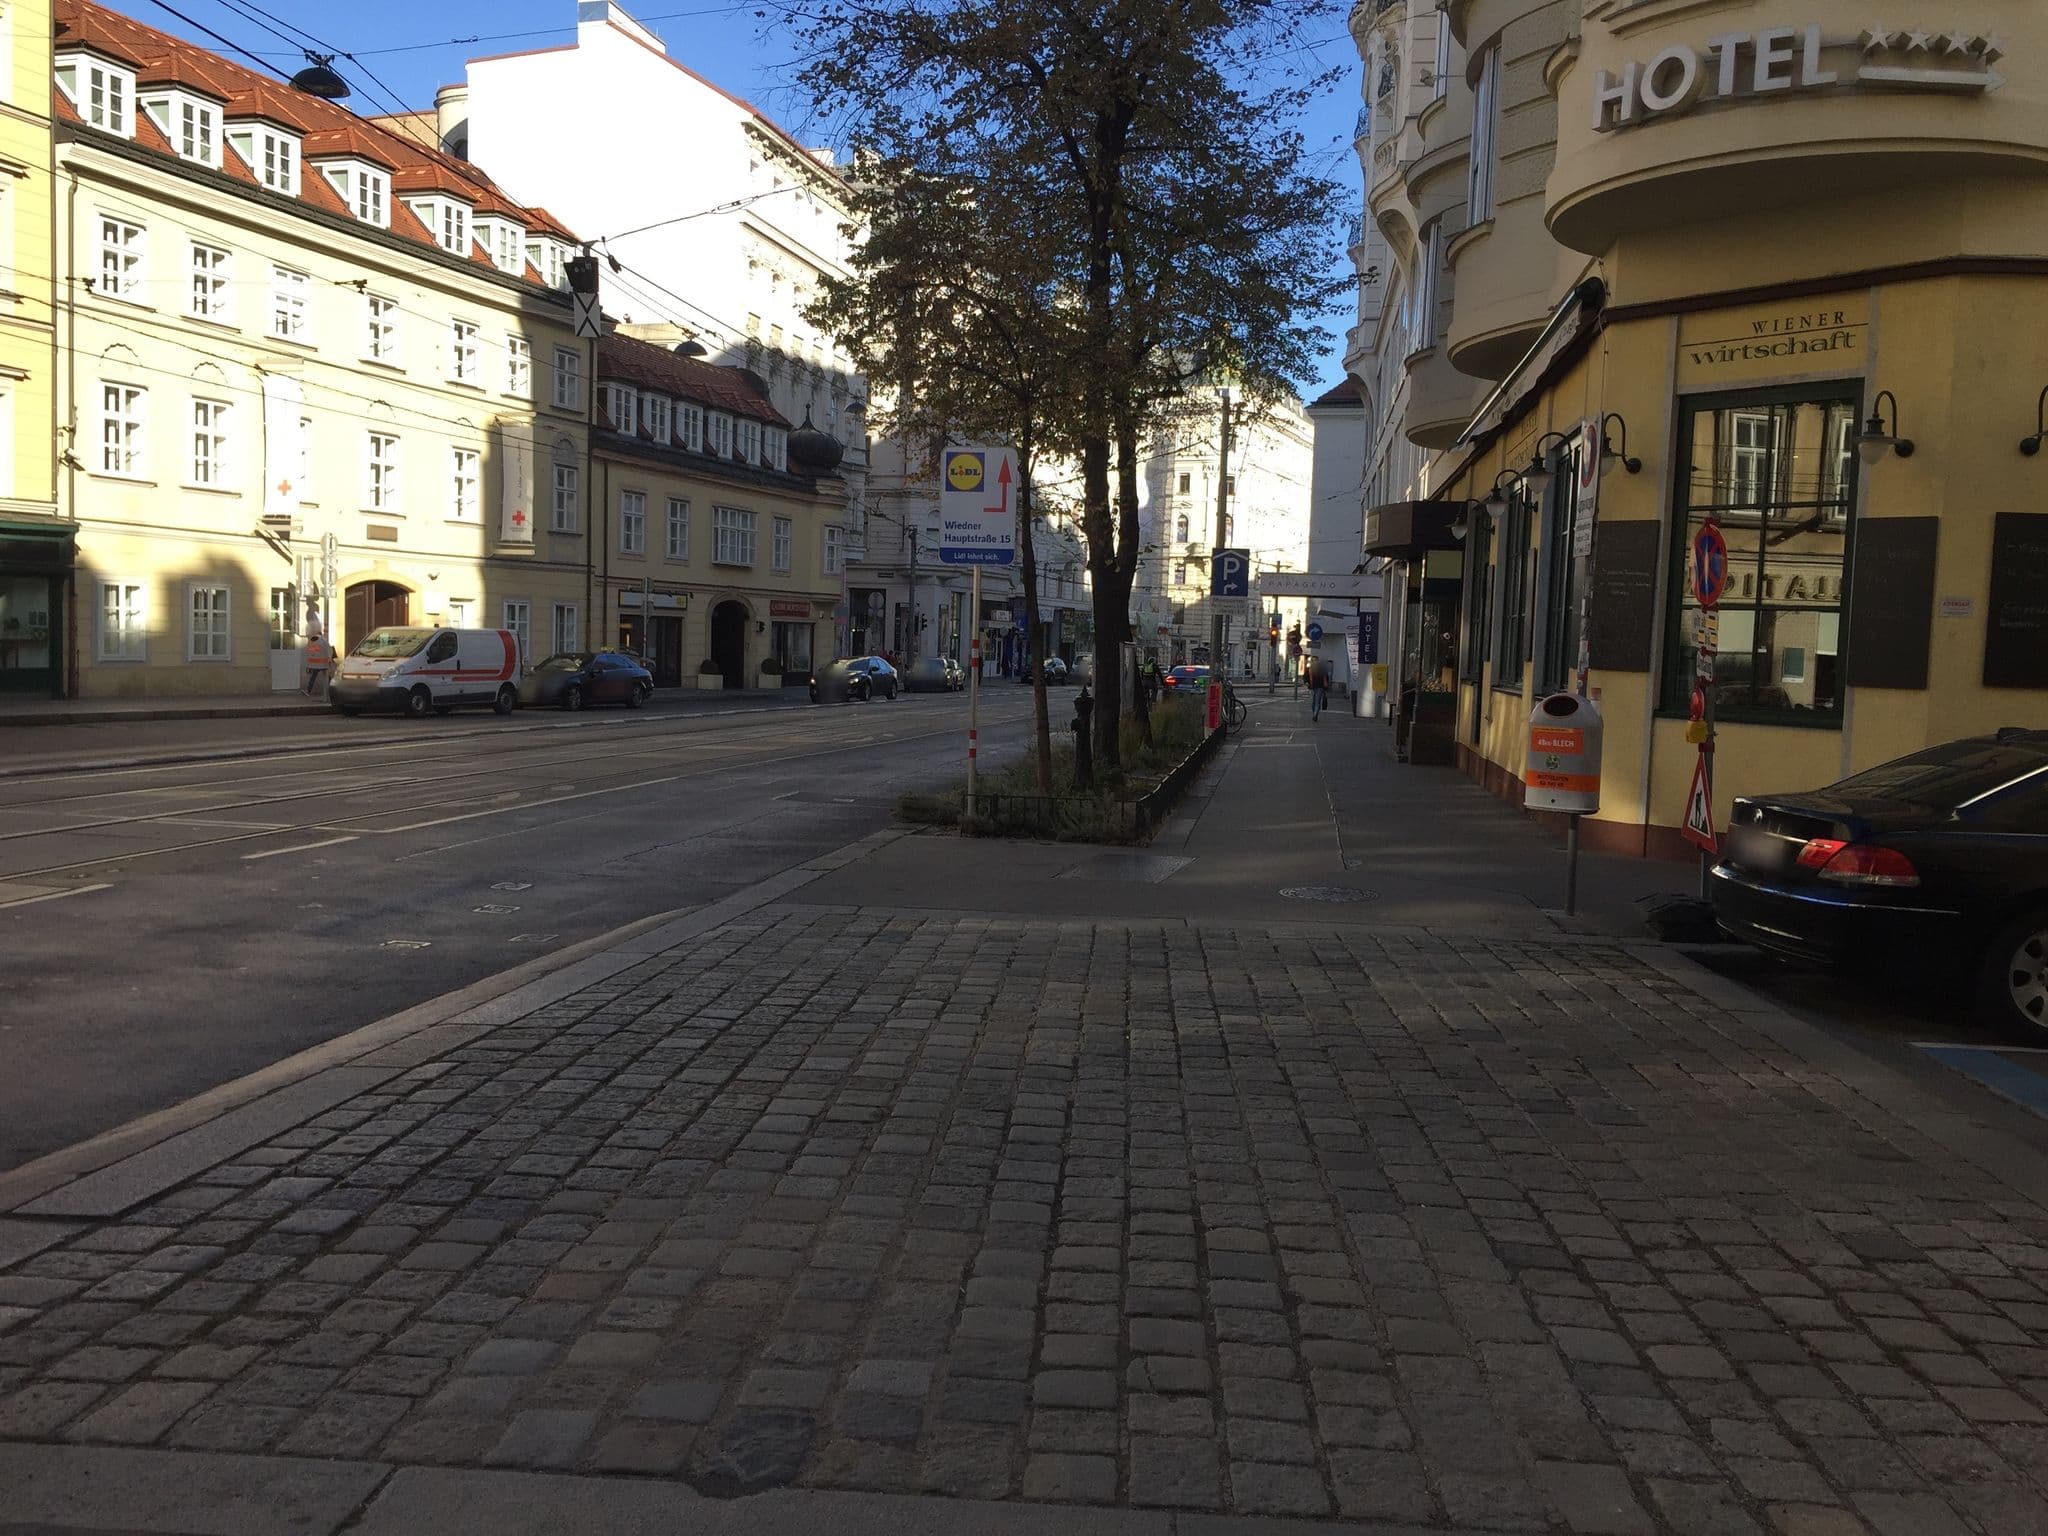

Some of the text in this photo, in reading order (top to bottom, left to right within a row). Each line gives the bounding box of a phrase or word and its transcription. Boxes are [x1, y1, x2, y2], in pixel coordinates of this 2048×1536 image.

[1592, 23, 1838, 133] HOTEL
[1752, 311, 1845, 335] WIENER
[1690, 330, 1856, 365] wirtschaft
[944, 520, 982, 530] Wiedner
[944, 533, 1011, 544] Hauptstraße 15
[1223, 557, 1240, 581] P
[1268, 581, 1336, 589] PAPAGENO
[1364, 615, 1372, 662] HOTEL
